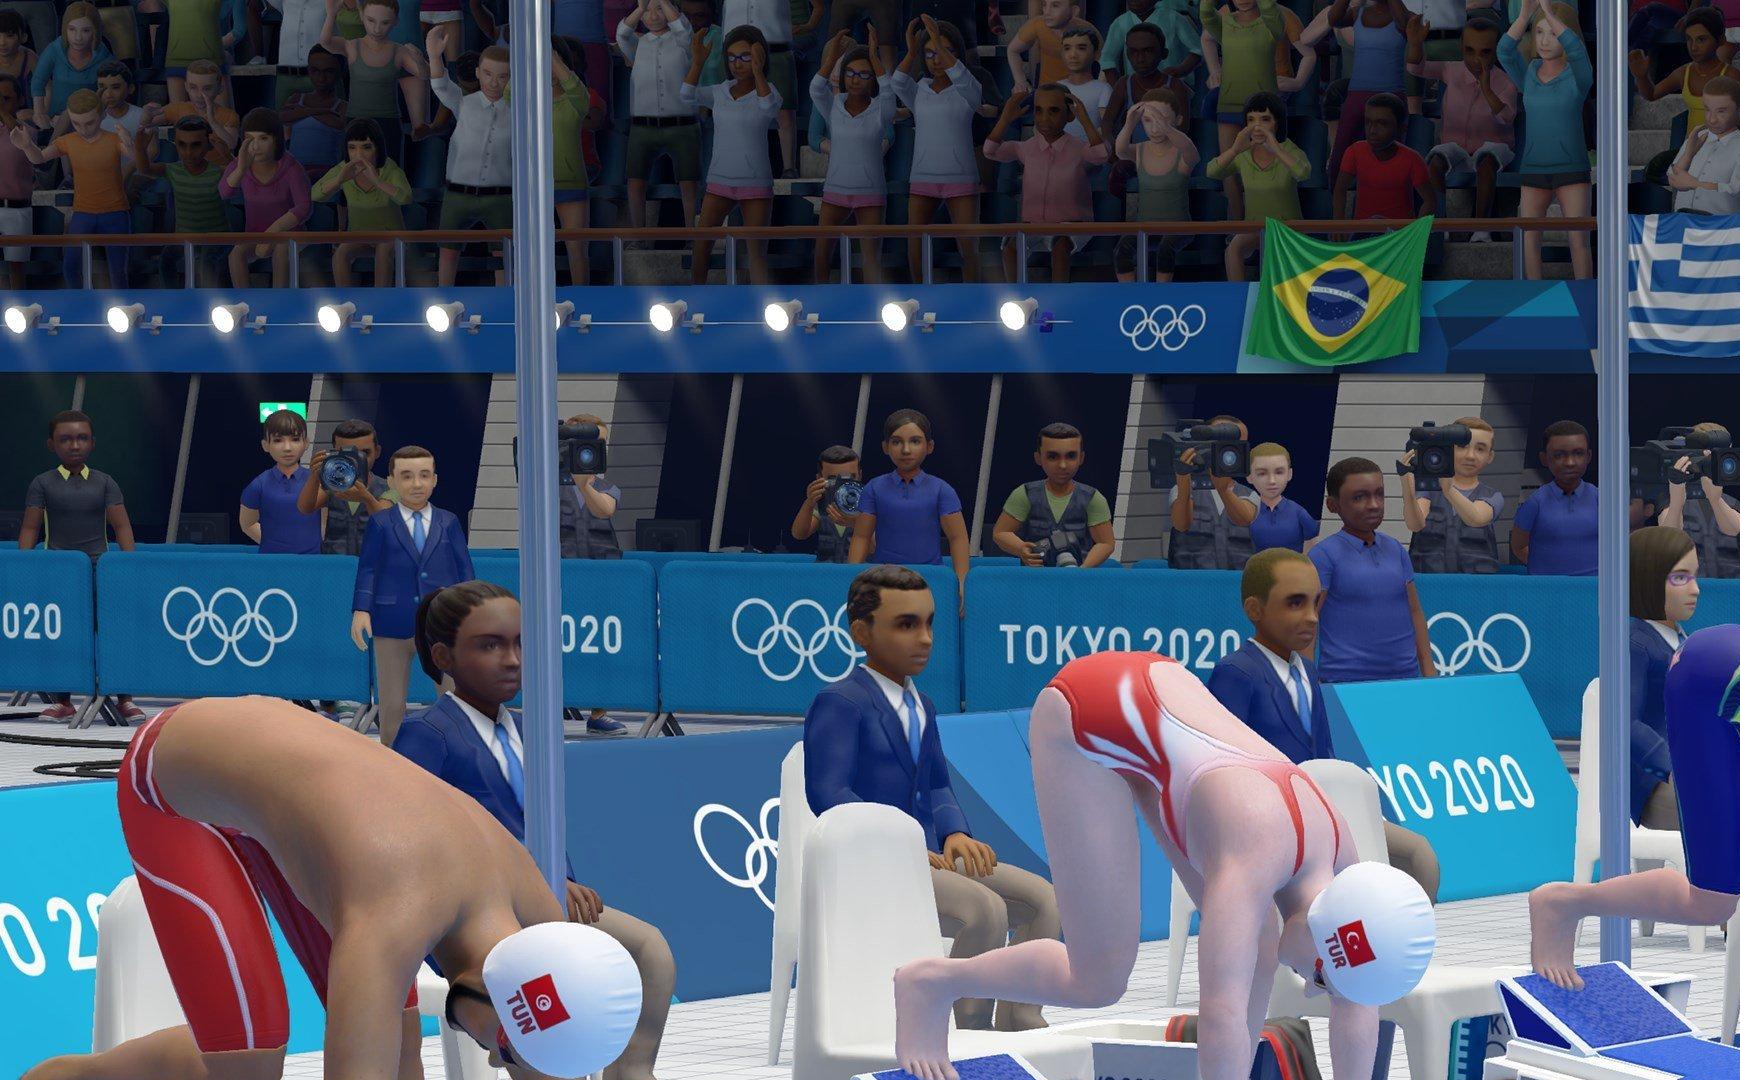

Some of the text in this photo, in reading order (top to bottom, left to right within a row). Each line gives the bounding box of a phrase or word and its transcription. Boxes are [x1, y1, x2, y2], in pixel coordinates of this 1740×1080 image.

[999, 623, 1242, 669] TOKYO 2020
[1428, 754, 1536, 817] 2020
[1325, 932, 1347, 969] TUR
[506, 990, 537, 1035] TUN
